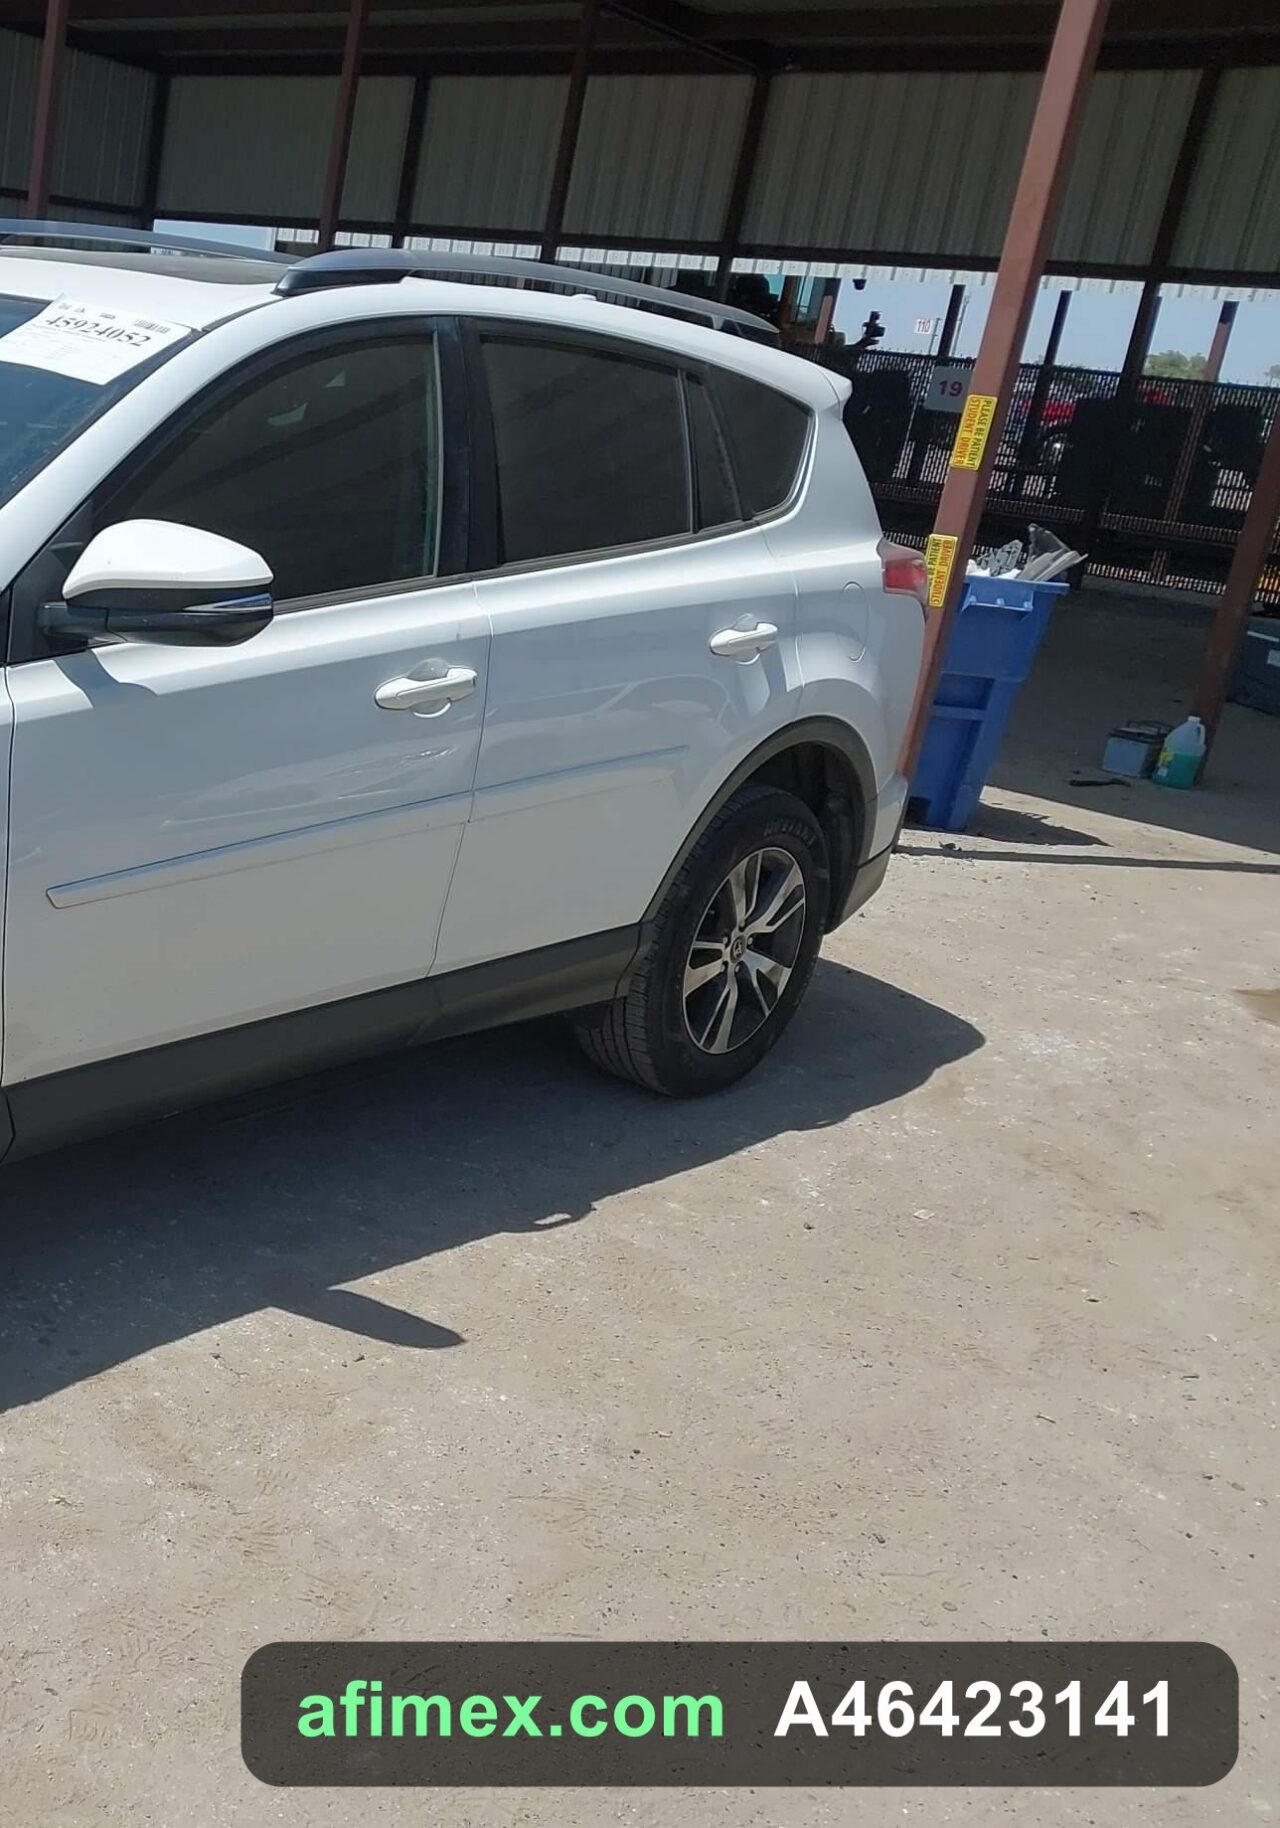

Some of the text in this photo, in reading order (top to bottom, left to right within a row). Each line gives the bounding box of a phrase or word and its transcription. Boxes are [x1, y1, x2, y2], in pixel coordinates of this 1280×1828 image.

[45, 316, 151, 347] 45924052
[939, 380, 963, 397] 19
[953, 397, 980, 465] STUDENT DRIVER
[966, 400, 993, 466] PLEASE BE PATIENT
[928, 538, 941, 566] PATIENT
[931, 540, 953, 604] STUDENT DRIVER
